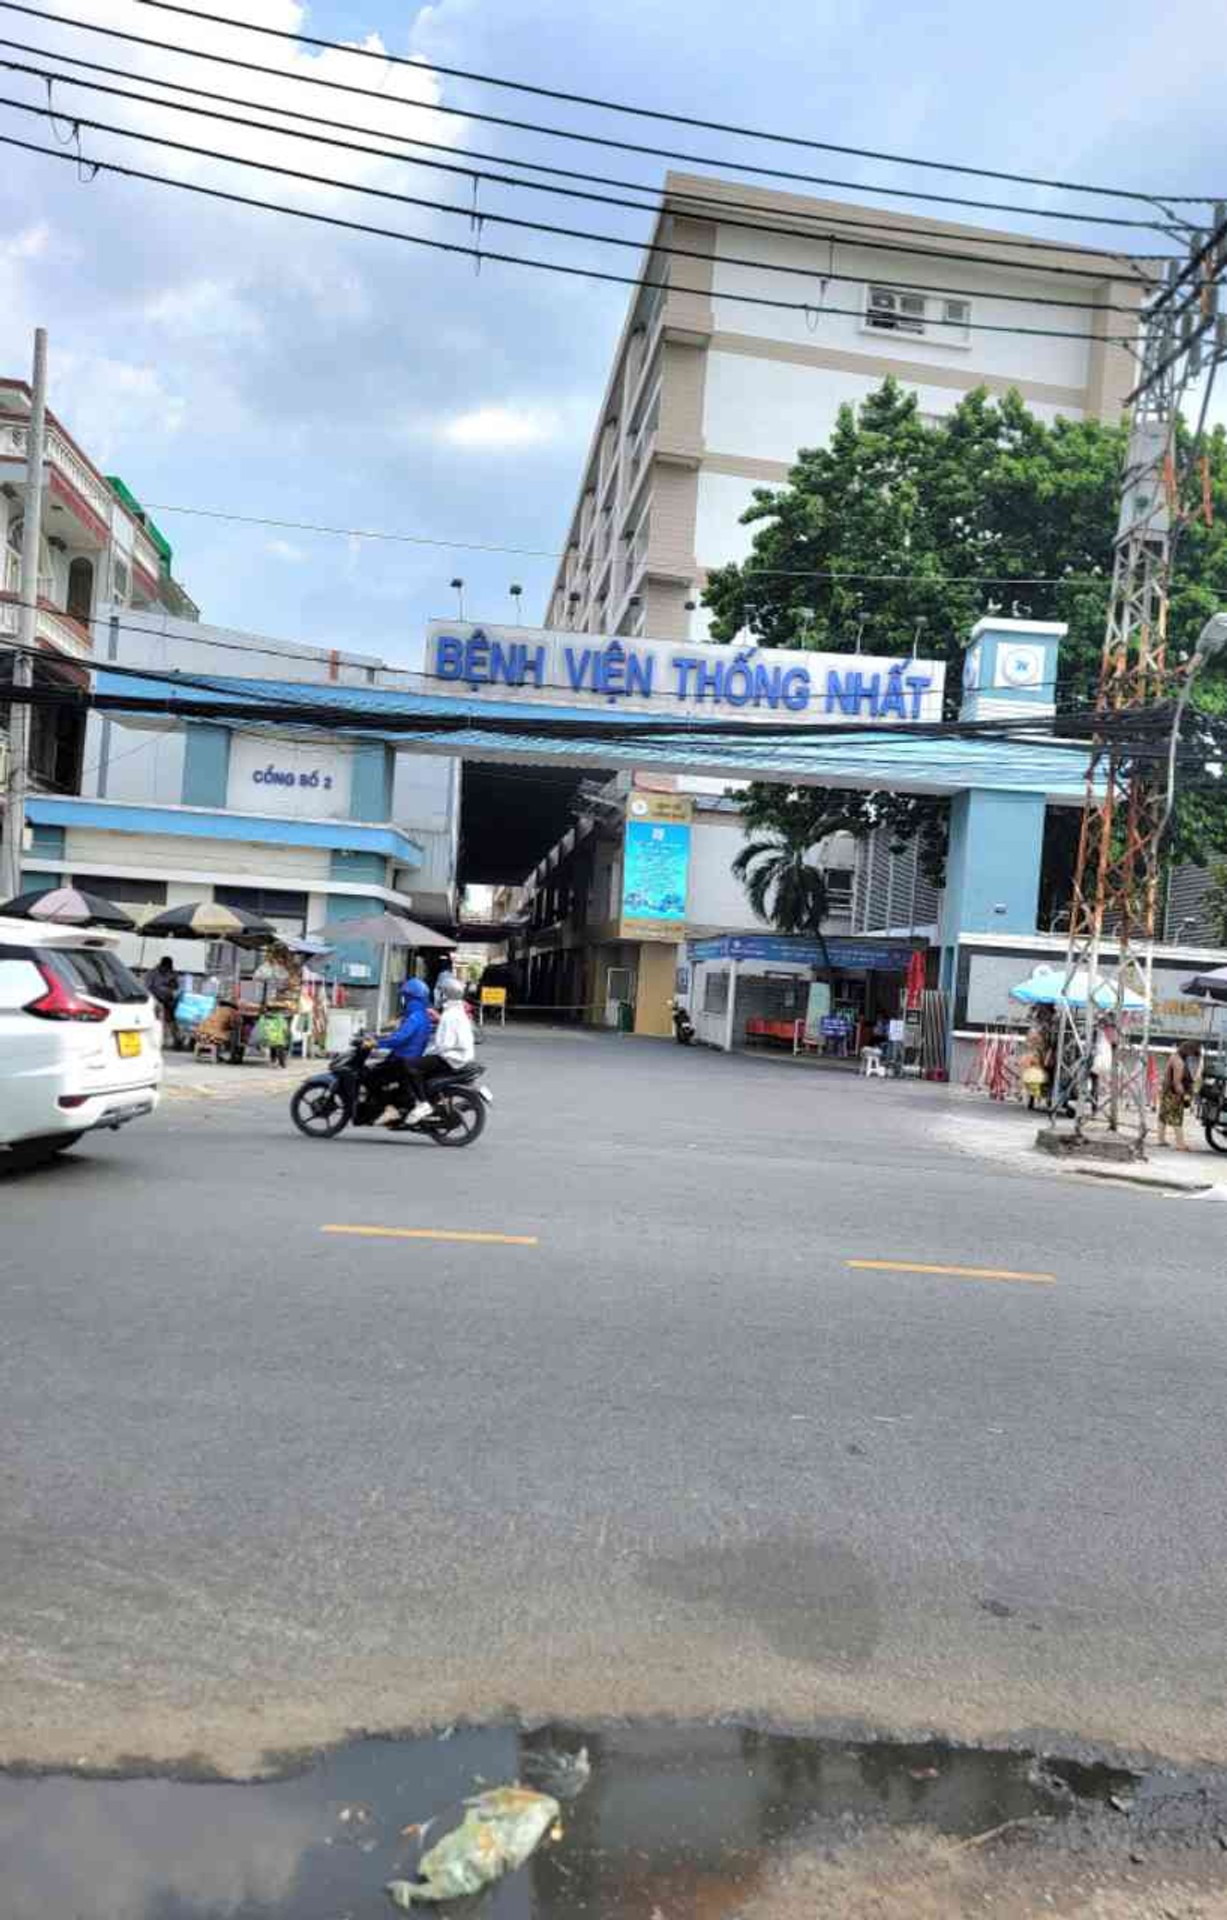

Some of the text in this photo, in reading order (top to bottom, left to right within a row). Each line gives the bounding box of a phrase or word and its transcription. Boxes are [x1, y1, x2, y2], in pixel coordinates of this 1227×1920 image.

[435, 628, 932, 720] BỆNH VIỆN THỐNG NHẤT
[299, 769, 320, 788] SỐ
[323, 775, 333, 790] 2
